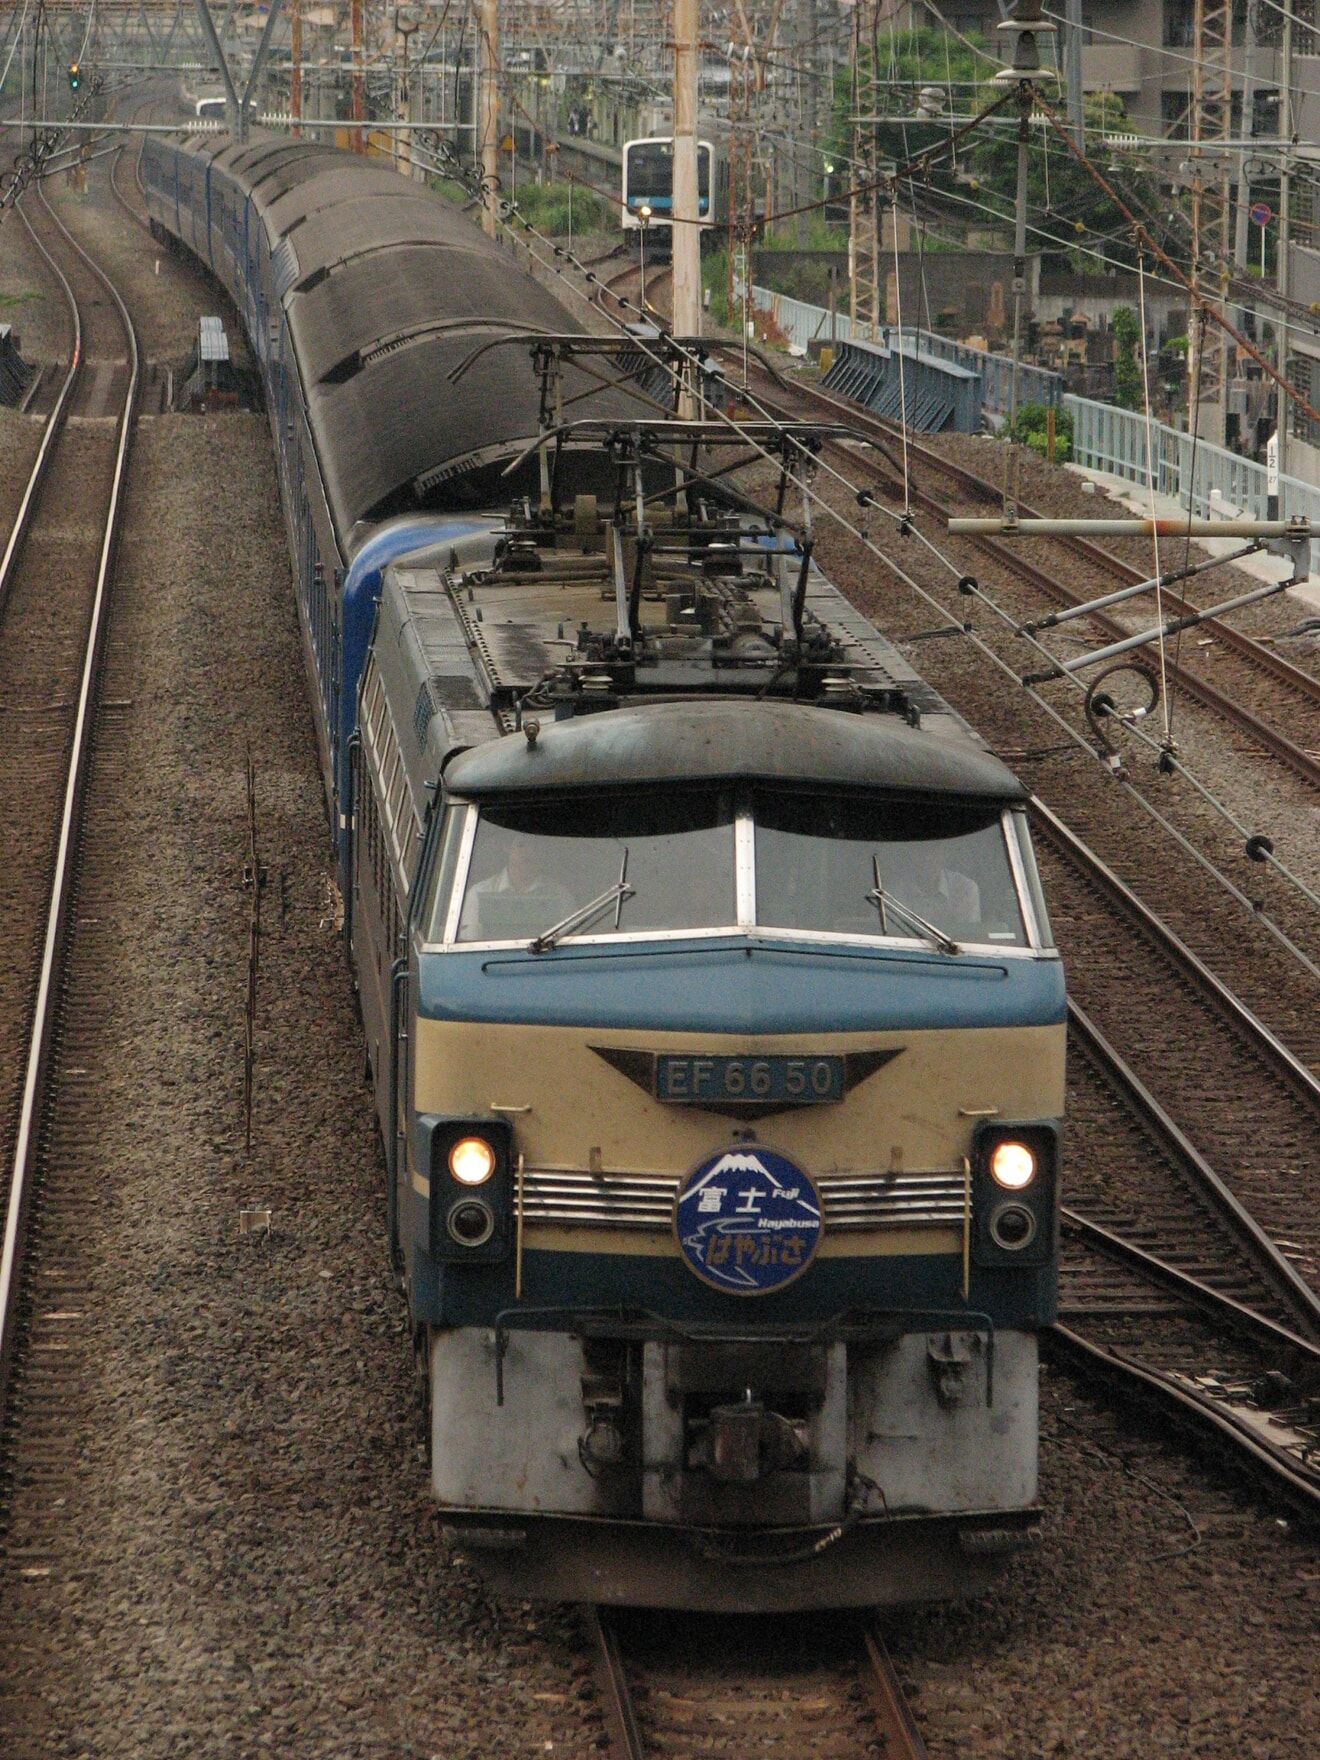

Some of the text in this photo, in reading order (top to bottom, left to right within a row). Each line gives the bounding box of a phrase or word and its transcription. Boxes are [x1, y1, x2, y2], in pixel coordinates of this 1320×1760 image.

[666, 1060, 832, 1095] EF 66 50
[697, 1185, 767, 1213] 富士
[757, 1218, 820, 1230] Hayabusa
[705, 1233, 807, 1266] はやぶさ
